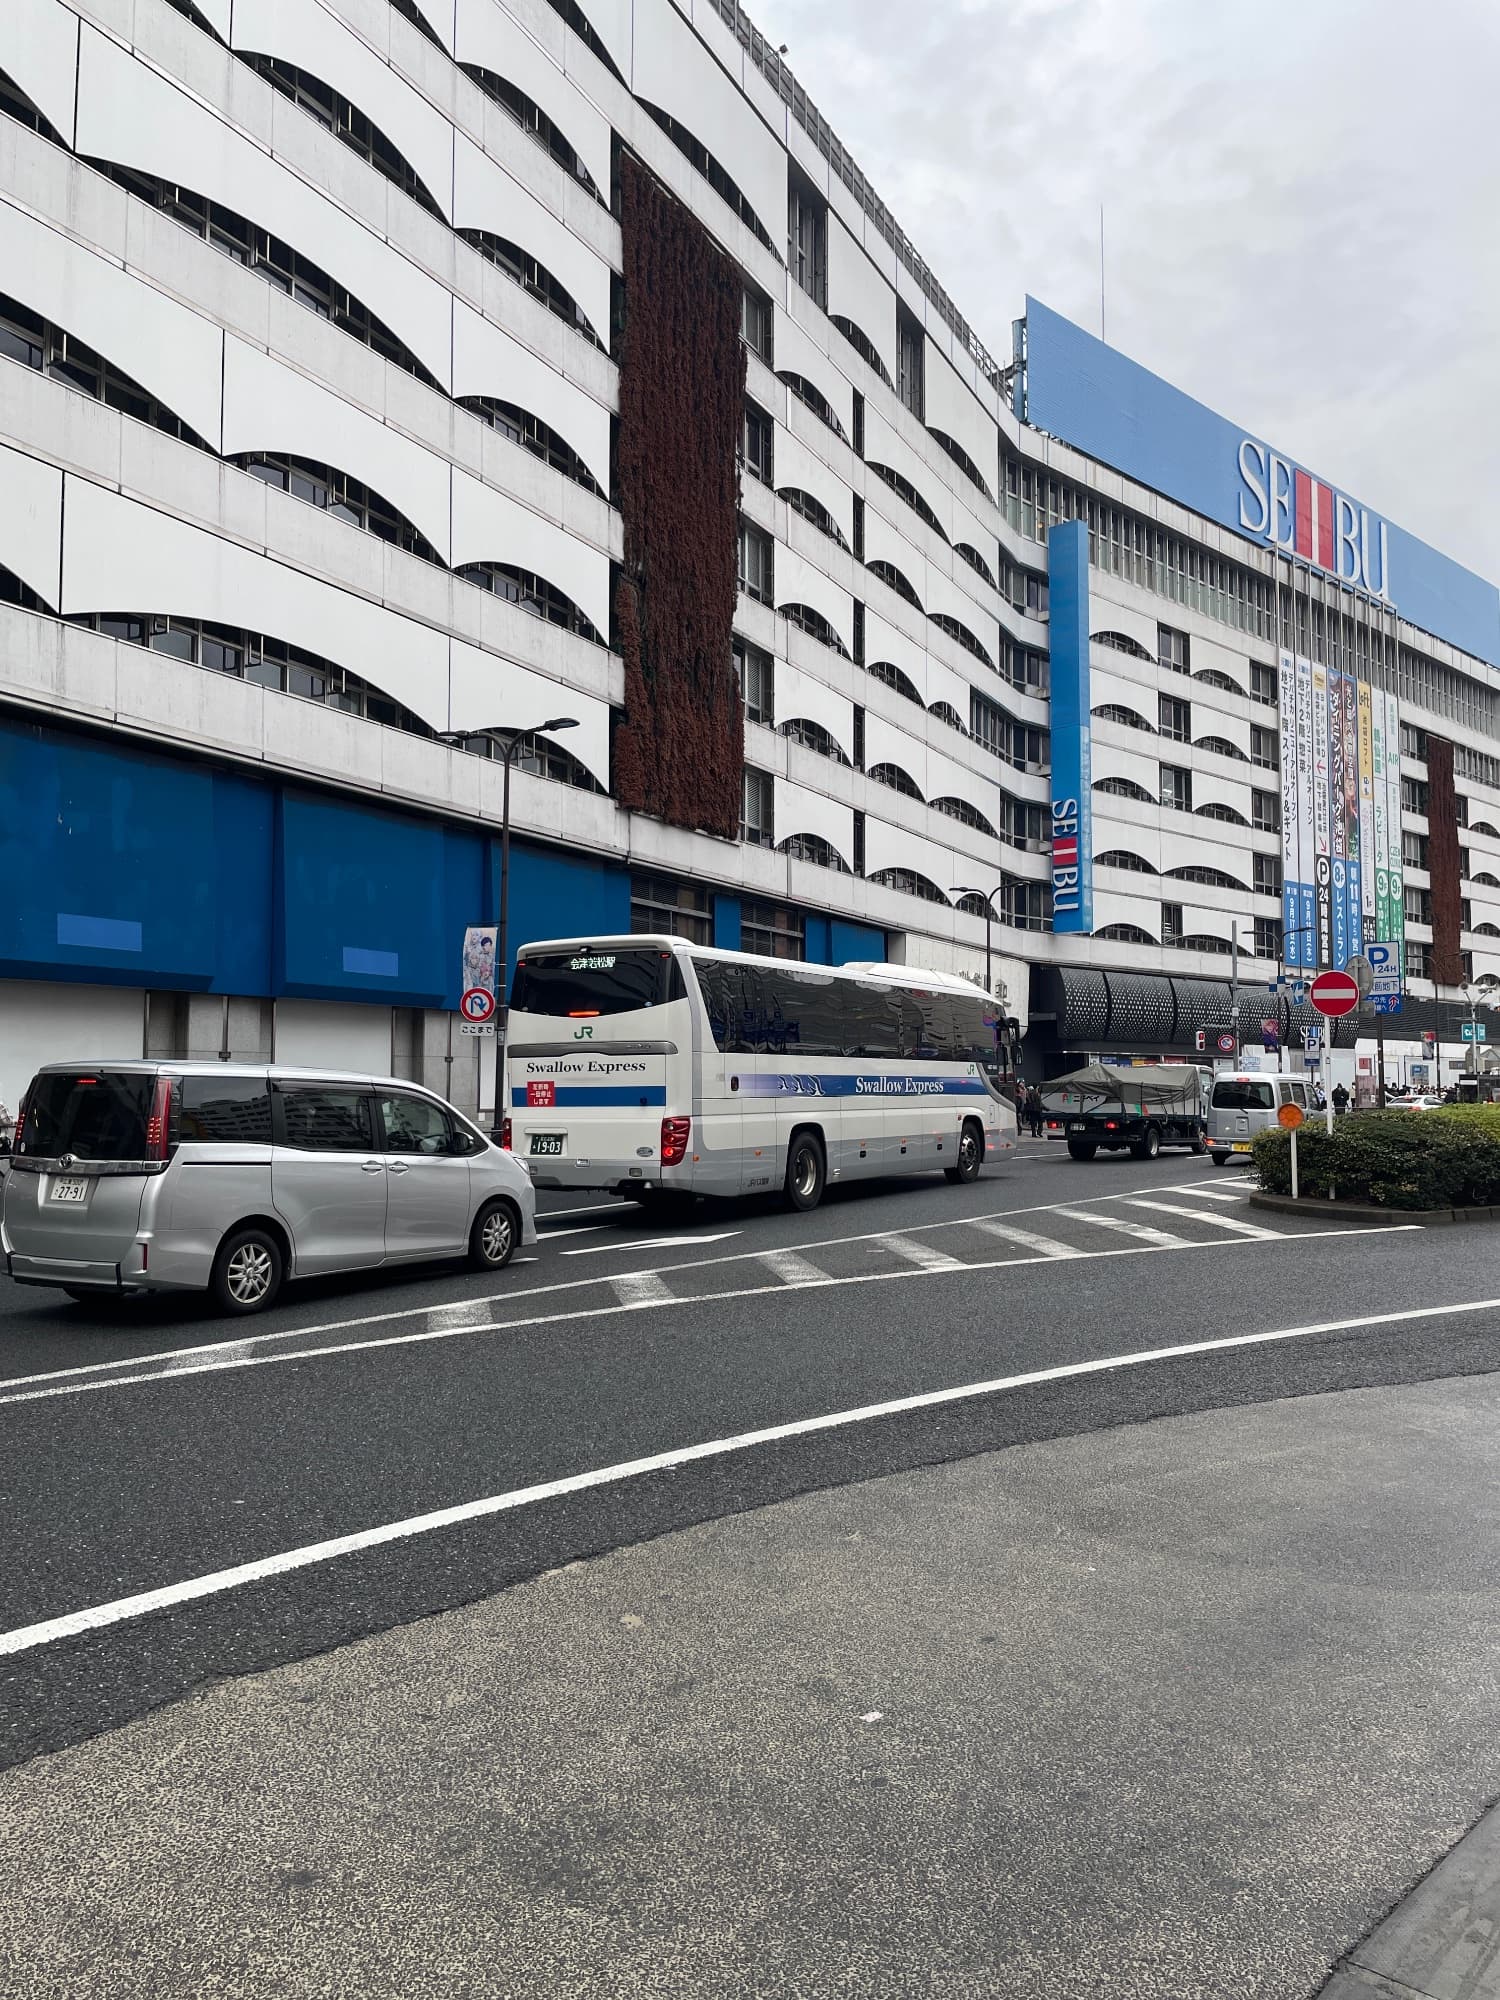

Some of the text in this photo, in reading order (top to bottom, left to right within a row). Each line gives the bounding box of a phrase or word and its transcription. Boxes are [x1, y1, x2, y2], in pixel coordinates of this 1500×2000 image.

[1238, 439, 1390, 601] SEIBU
[1052, 799, 1080, 912] SEIBU
[1336, 890, 1344, 966] レストラン
[1368, 947, 1389, 973] P
[1377, 964, 1397, 974] 24H
[461, 1026, 493, 1034] ここまで
[574, 1026, 593, 1039] JR
[1307, 1039, 1316, 1050] P
[526, 1060, 646, 1074] Swallow Express
[967, 1064, 974, 1075] JR
[855, 1077, 944, 1096] Swallow Express
[58, 1186, 84, 1199] 27-91
